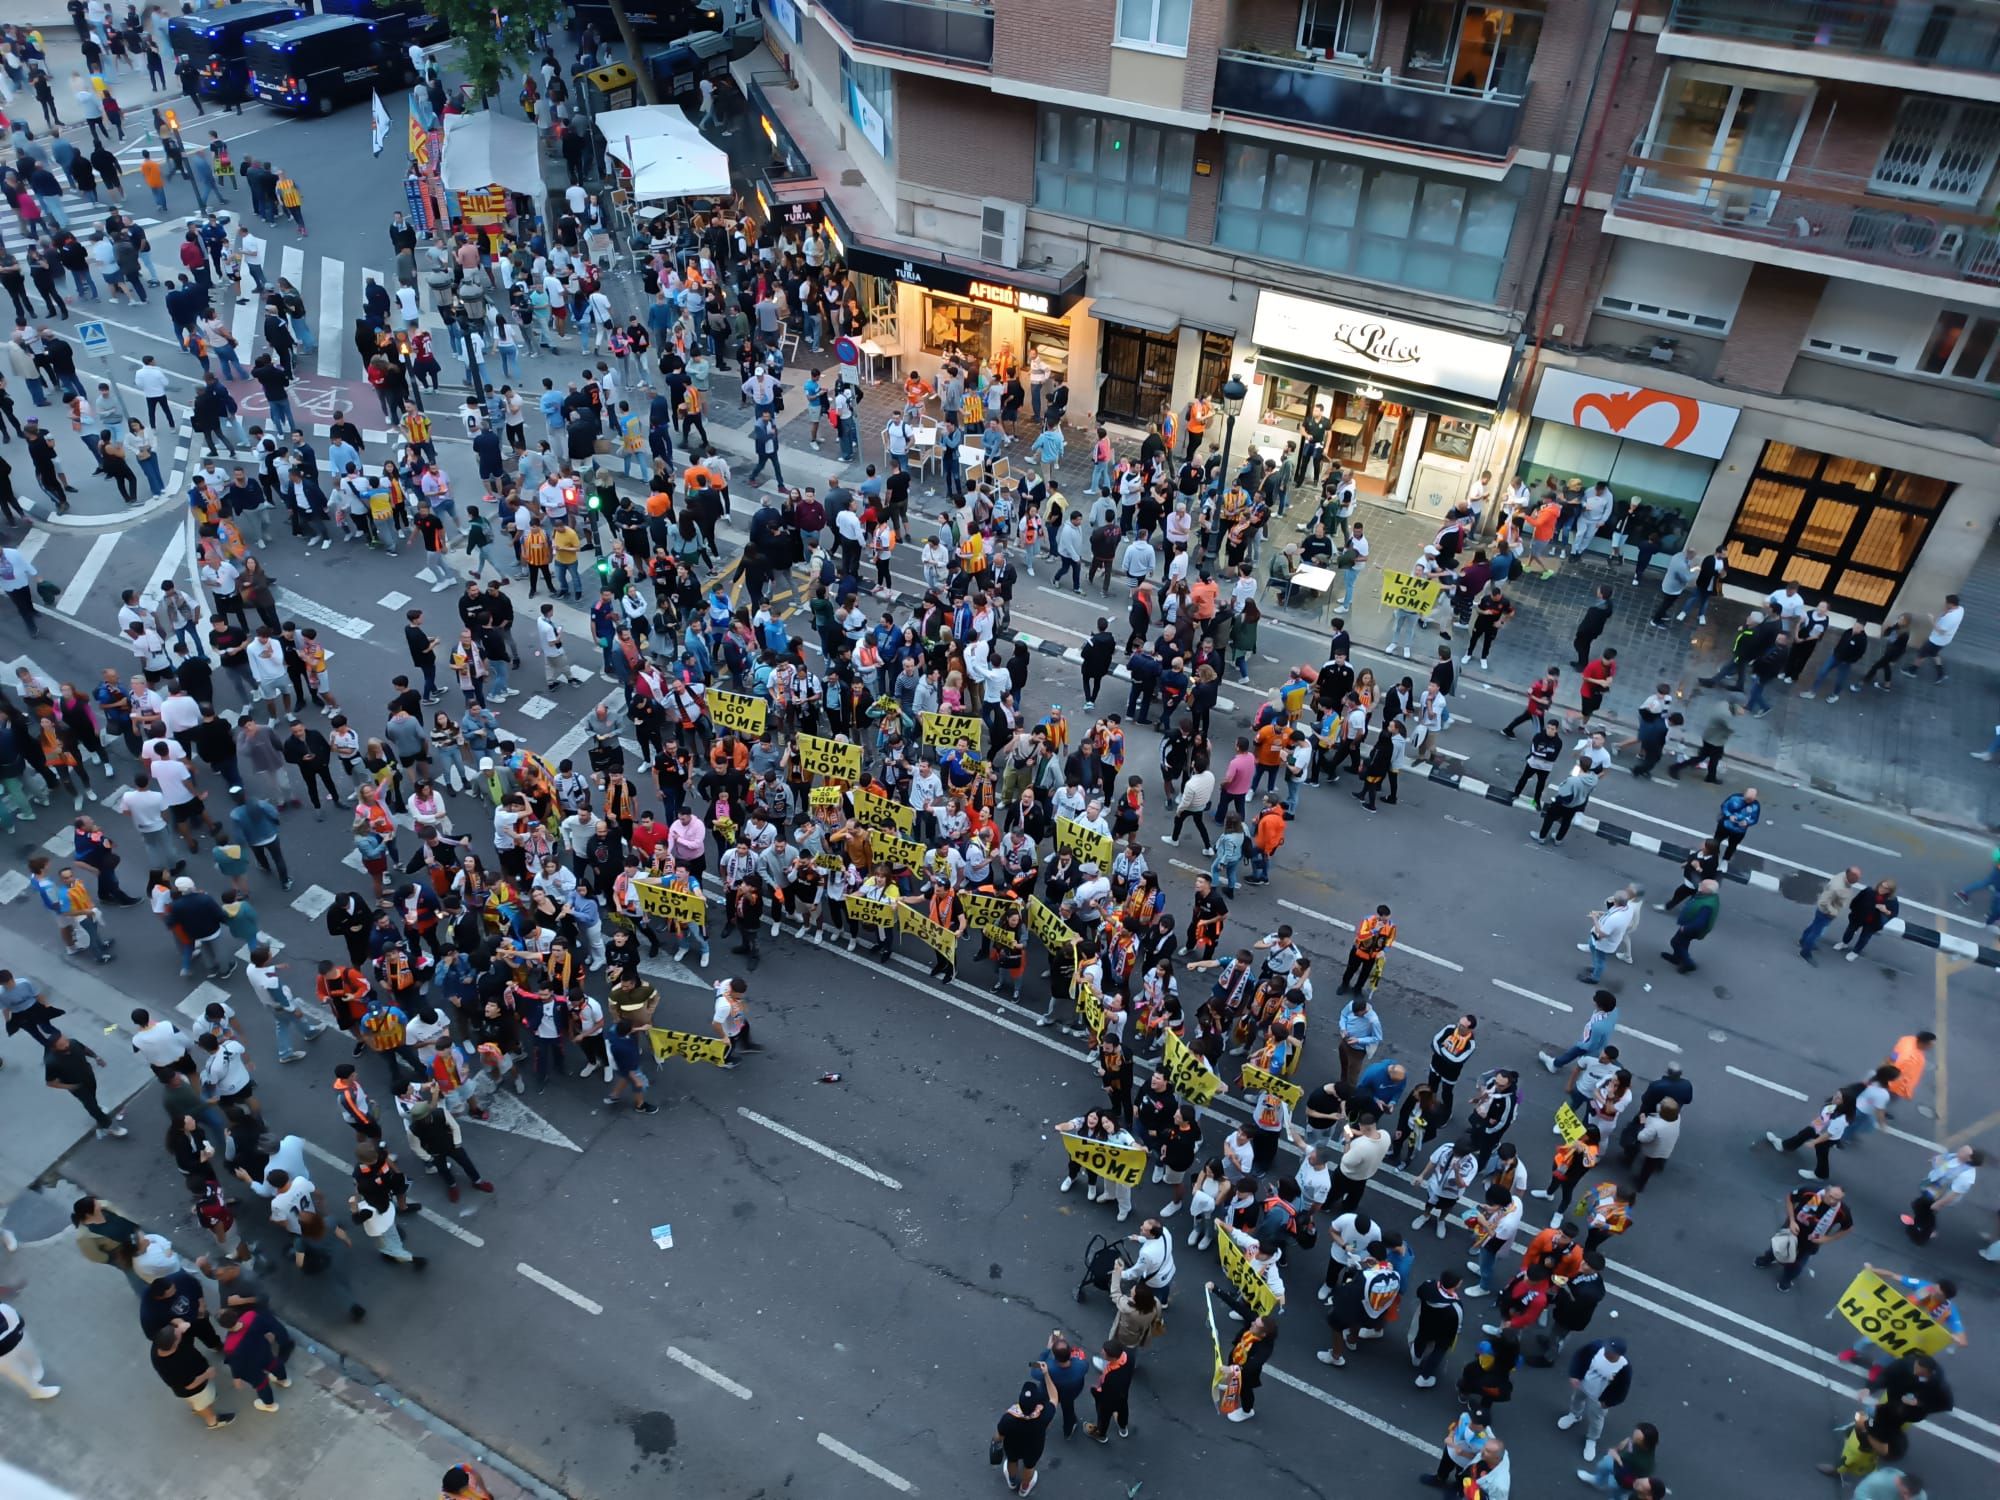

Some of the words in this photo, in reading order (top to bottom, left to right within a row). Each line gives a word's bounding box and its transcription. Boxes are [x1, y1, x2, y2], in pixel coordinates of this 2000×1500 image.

[784, 212, 812, 221] TURIA
[895, 268, 921, 281] TURIA
[1394, 573, 1430, 591] LIM
[1400, 586, 1418, 597] GO
[1383, 592, 1430, 612] HOME
[717, 691, 753, 707] LIM
[726, 703, 744, 714] GO
[713, 710, 762, 732] HOME
[934, 715, 972, 729] LIM
[942, 728, 962, 736] GO
[812, 738, 849, 756] LIM
[925, 733, 978, 751] HOE
[820, 753, 840, 764] GO
[804, 758, 857, 780] HOME
[865, 793, 901, 814] LIM
[874, 806, 892, 818] GO
[880, 832, 918, 852] LIM
[1068, 822, 1102, 846] LIM
[889, 846, 909, 858] GO
[1075, 838, 1092, 852] GO
[873, 851, 924, 877] HOME
[648, 886, 688, 902] LIM
[660, 896, 681, 906] GO
[644, 899, 702, 922] HOME
[855, 899, 885, 911] LIM
[862, 907, 877, 915] GO
[970, 895, 1011, 911] LIM
[850, 910, 892, 926] HOME
[980, 908, 1001, 919] GO
[1037, 905, 1067, 937] LIM
[909, 911, 944, 936] LIM
[1041, 925, 1057, 941] GO
[667, 1031, 713, 1045] LIM
[677, 1042, 700, 1051] GO
[1175, 1041, 1208, 1077] LIM
[1176, 1063, 1191, 1081] GO
[1254, 1071, 1291, 1090] LIM
[1564, 1109, 1581, 1129] LIM
[1556, 1114, 1575, 1144] HOME
[1074, 1150, 1140, 1183] HOME
[1873, 1283, 1936, 1331] LIM
[1876, 1308, 1907, 1331] GO
